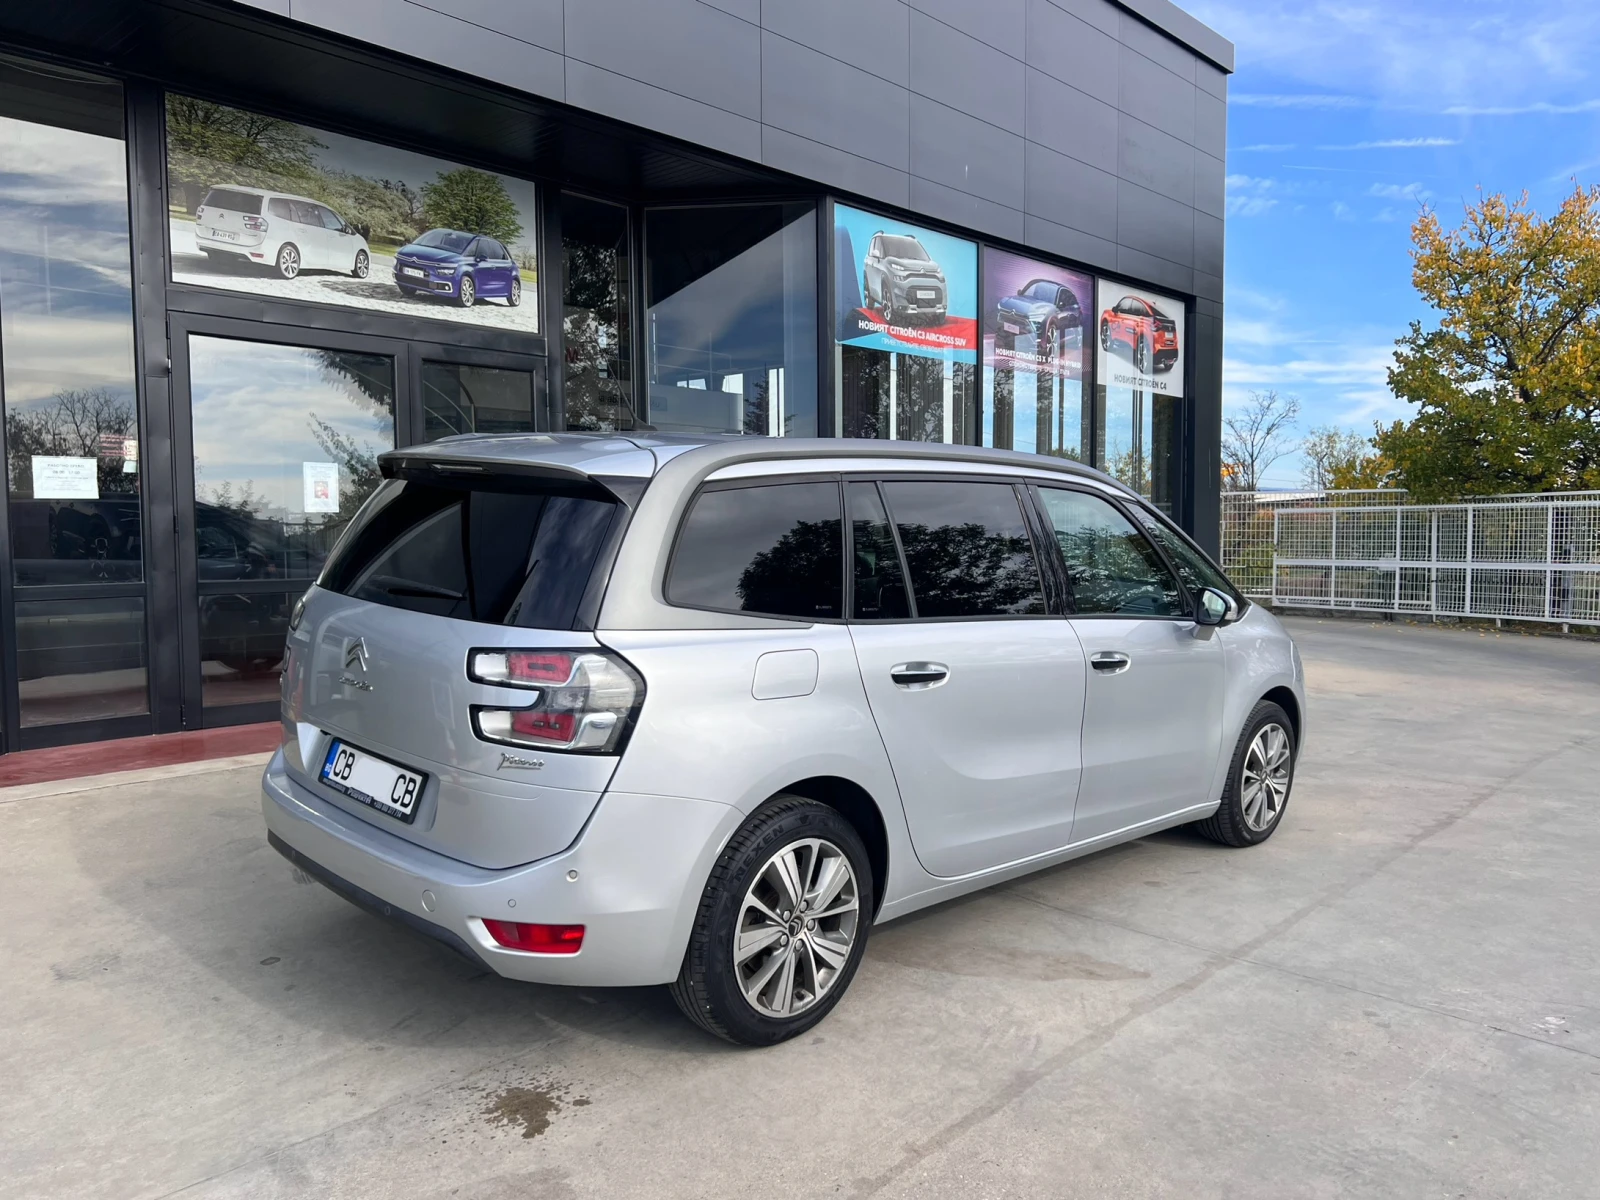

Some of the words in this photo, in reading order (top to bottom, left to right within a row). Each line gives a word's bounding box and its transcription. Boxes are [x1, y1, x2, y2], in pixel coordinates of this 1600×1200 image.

[858, 319, 889, 334] НОВИЯТ
[890, 326, 917, 338] CITROËN
[917, 332, 926, 340] C3
[926, 333, 955, 345] AIRCROSS
[955, 338, 967, 347] SUV
[995, 347, 1016, 358] НОВИЯТ
[1114, 373, 1137, 386] НОВИЯТ
[1138, 377, 1159, 389] CITROËN
[1160, 381, 1167, 390] C4
[333, 749, 356, 781] CB
[391, 773, 417, 809] CB
[735, 825, 785, 882] NEXEN
